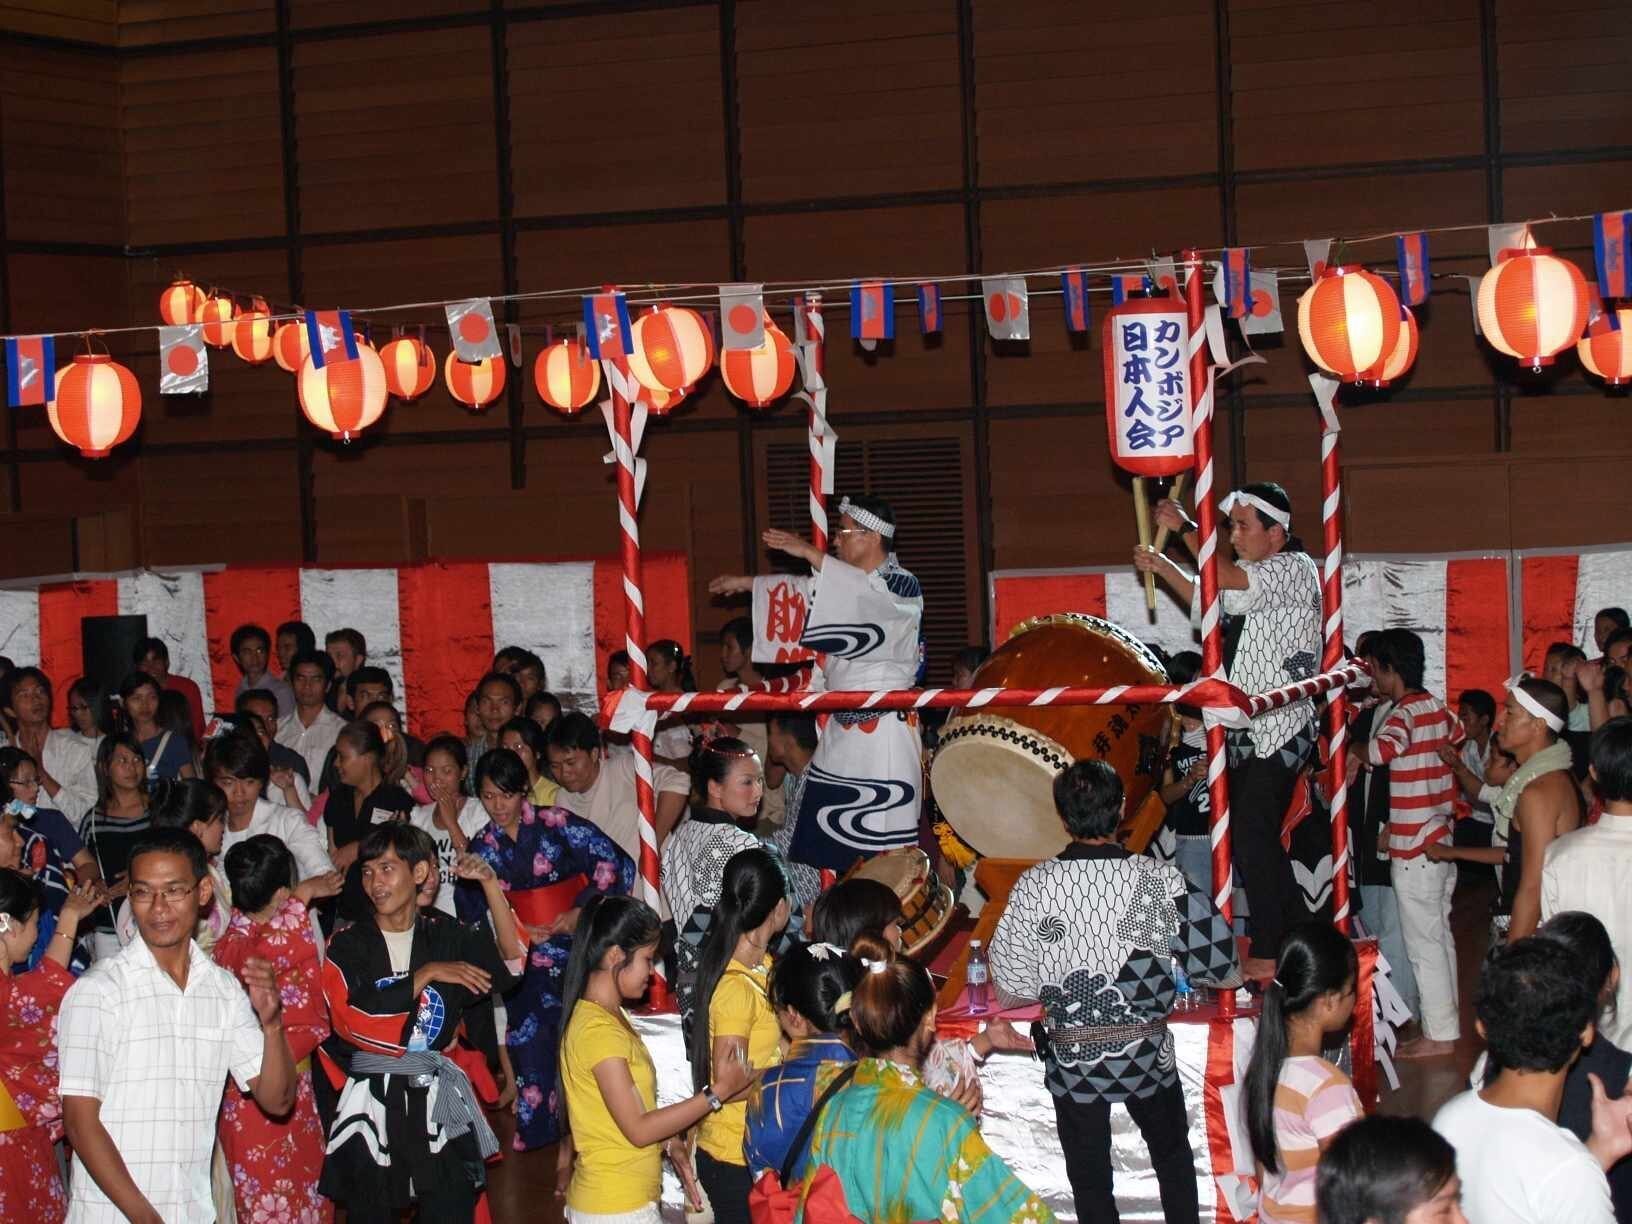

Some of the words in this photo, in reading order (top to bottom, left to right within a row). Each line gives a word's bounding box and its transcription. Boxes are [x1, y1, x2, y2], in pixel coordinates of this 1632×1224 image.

[1122, 321, 1156, 451] 日本人会
[1154, 319, 1185, 448] カンボジア
